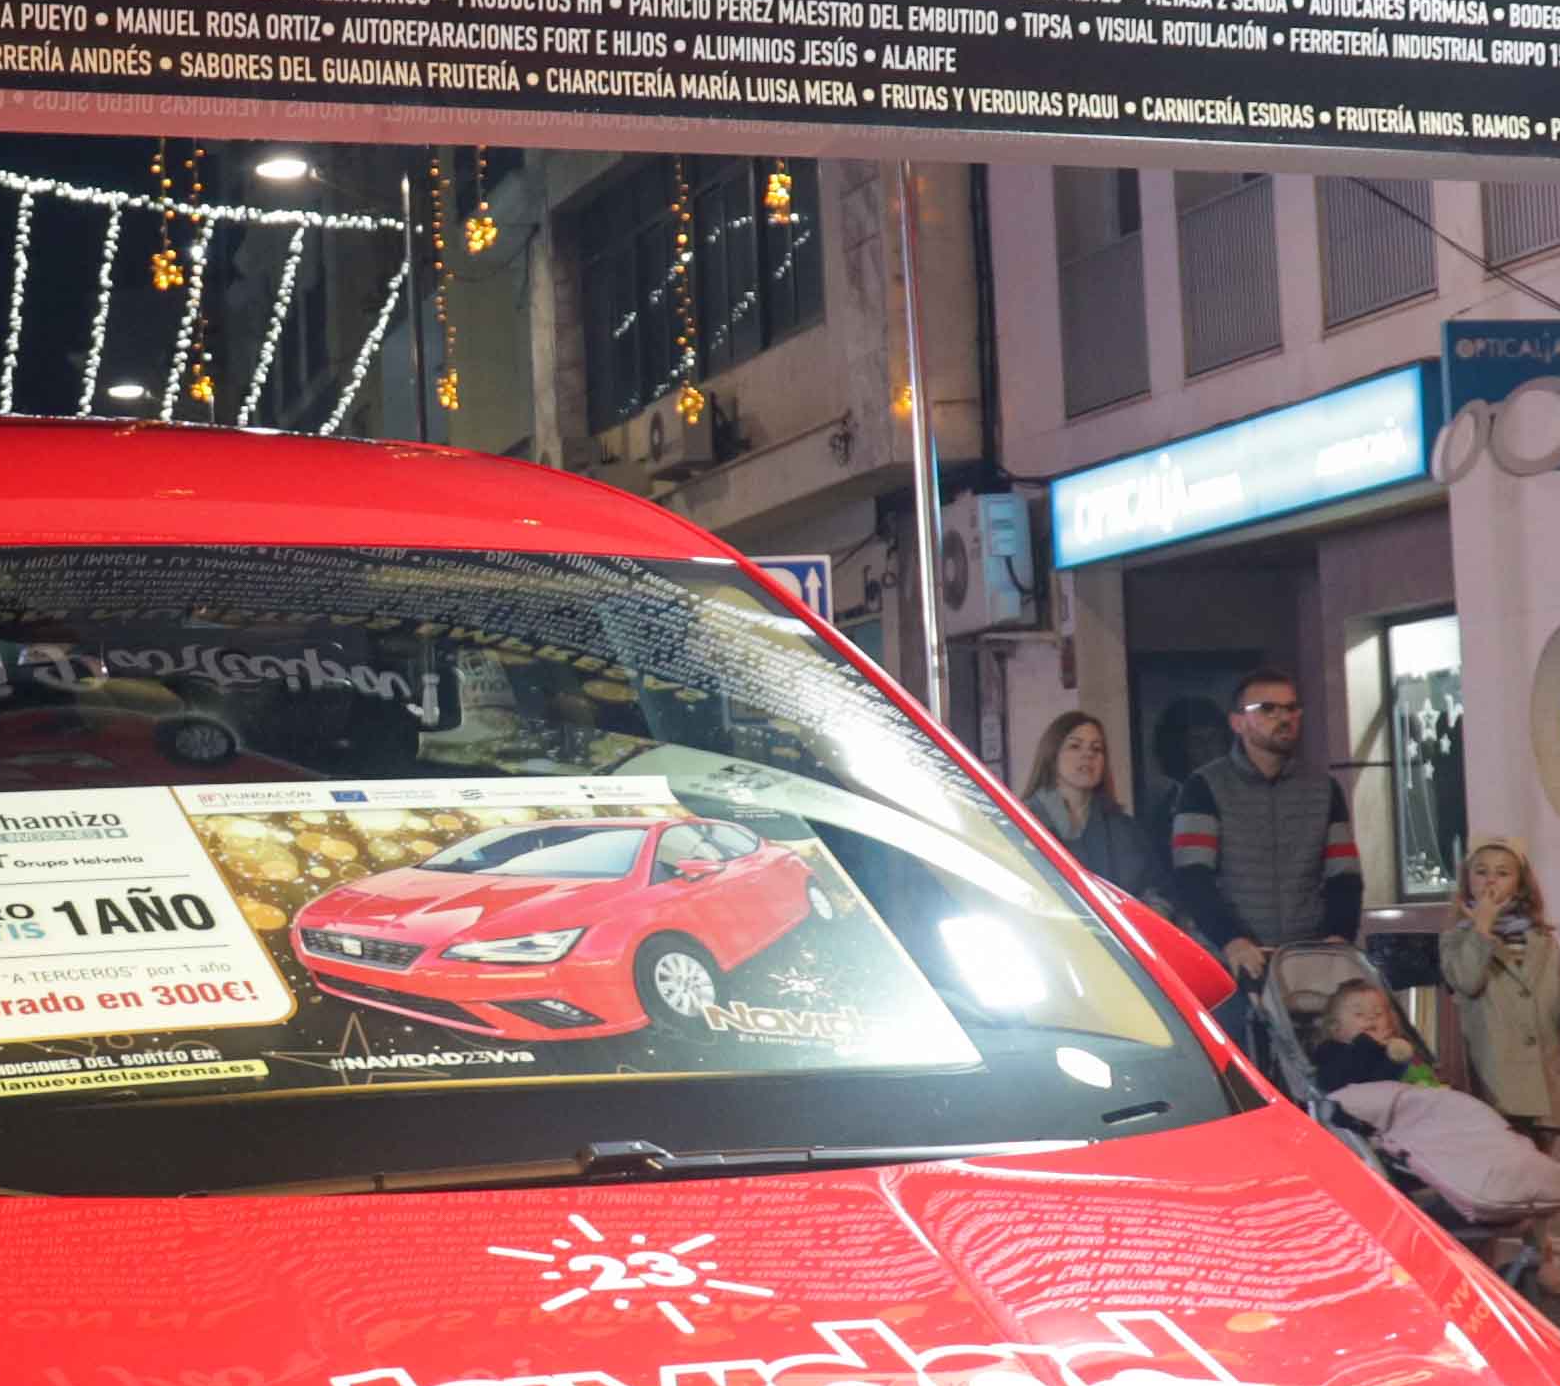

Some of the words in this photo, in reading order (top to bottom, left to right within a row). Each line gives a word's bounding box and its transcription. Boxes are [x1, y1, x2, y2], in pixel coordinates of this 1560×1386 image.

[21, 3, 87, 31] PUEYO
[70, 44, 152, 75] ANDRÉS
[13, 859, 69, 870] Grupo
[73, 854, 145, 866] Helvetia
[146, 962, 177, 979] por
[199, 959, 232, 974] año
[98, 990, 144, 1010] en
[151, 980, 261, 1008] 300€!
[85, 1054, 115, 1072] DEL
[121, 1050, 191, 1070] SORTEO
[193, 1048, 222, 1064] EN:
[570, 1251, 696, 1293] 23
